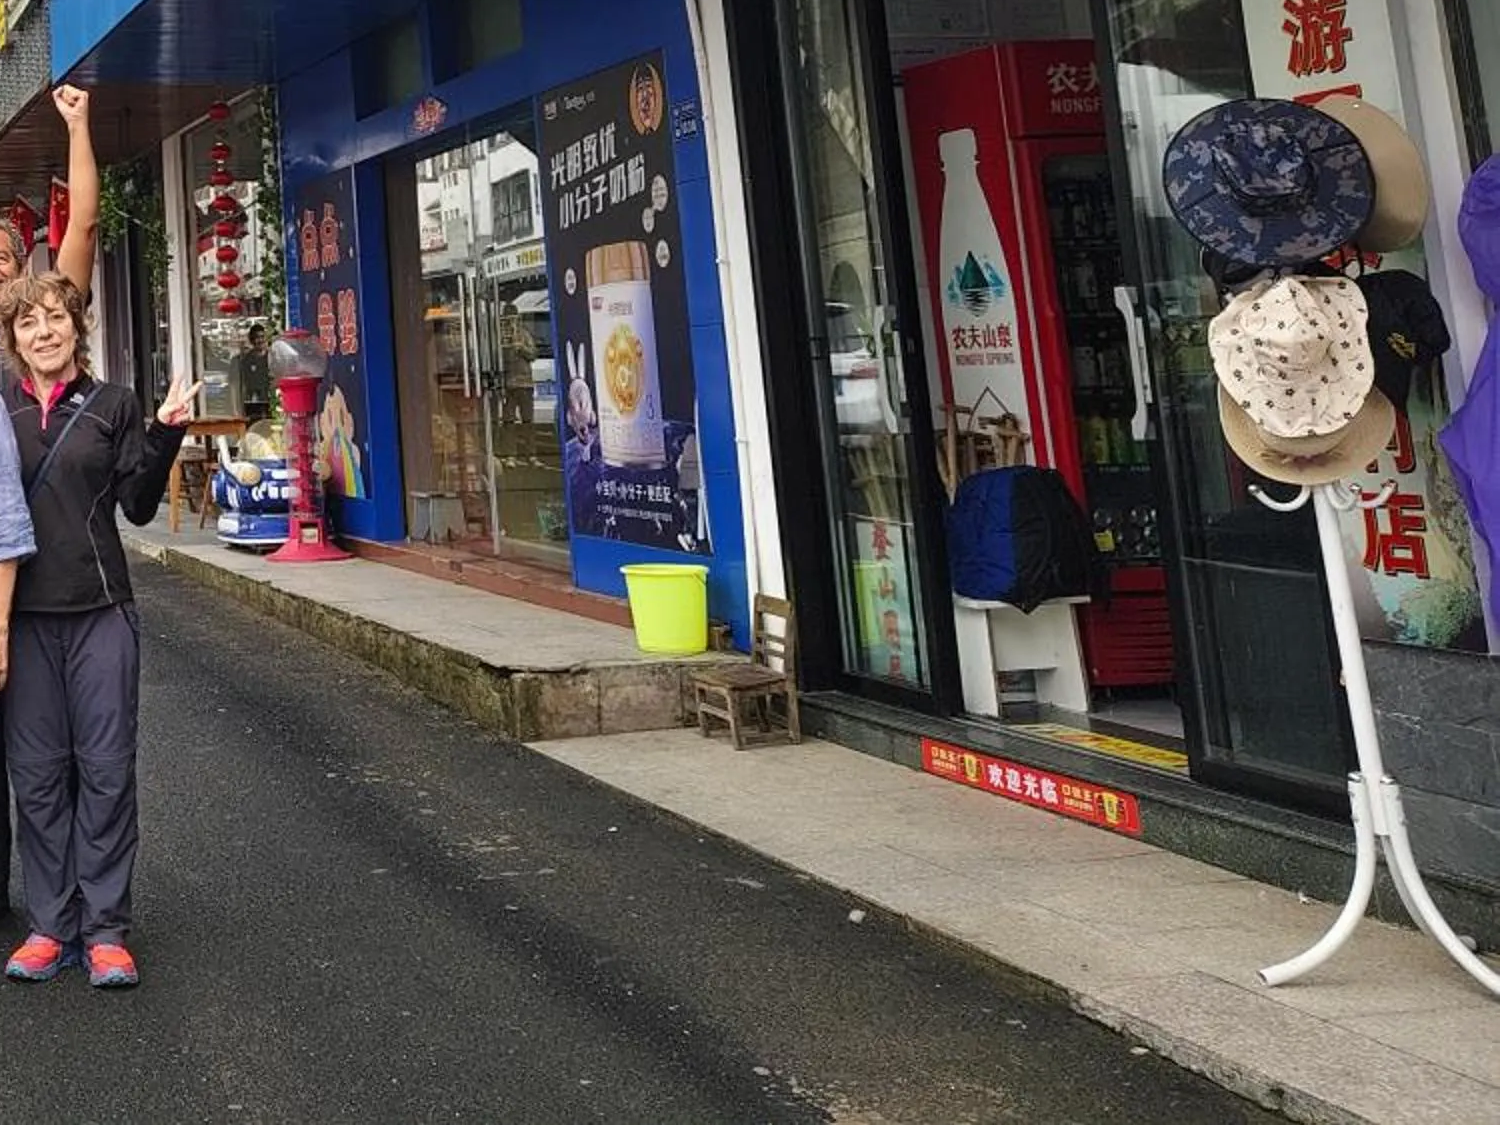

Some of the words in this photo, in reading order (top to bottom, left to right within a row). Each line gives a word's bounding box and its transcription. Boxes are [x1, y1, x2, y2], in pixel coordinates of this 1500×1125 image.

[551, 122, 617, 191] 光明致优
[559, 153, 645, 228] 小分子奶粉
[951, 320, 1013, 349] 农夫山泉
[987, 762, 1060, 806] 欢迎光临
